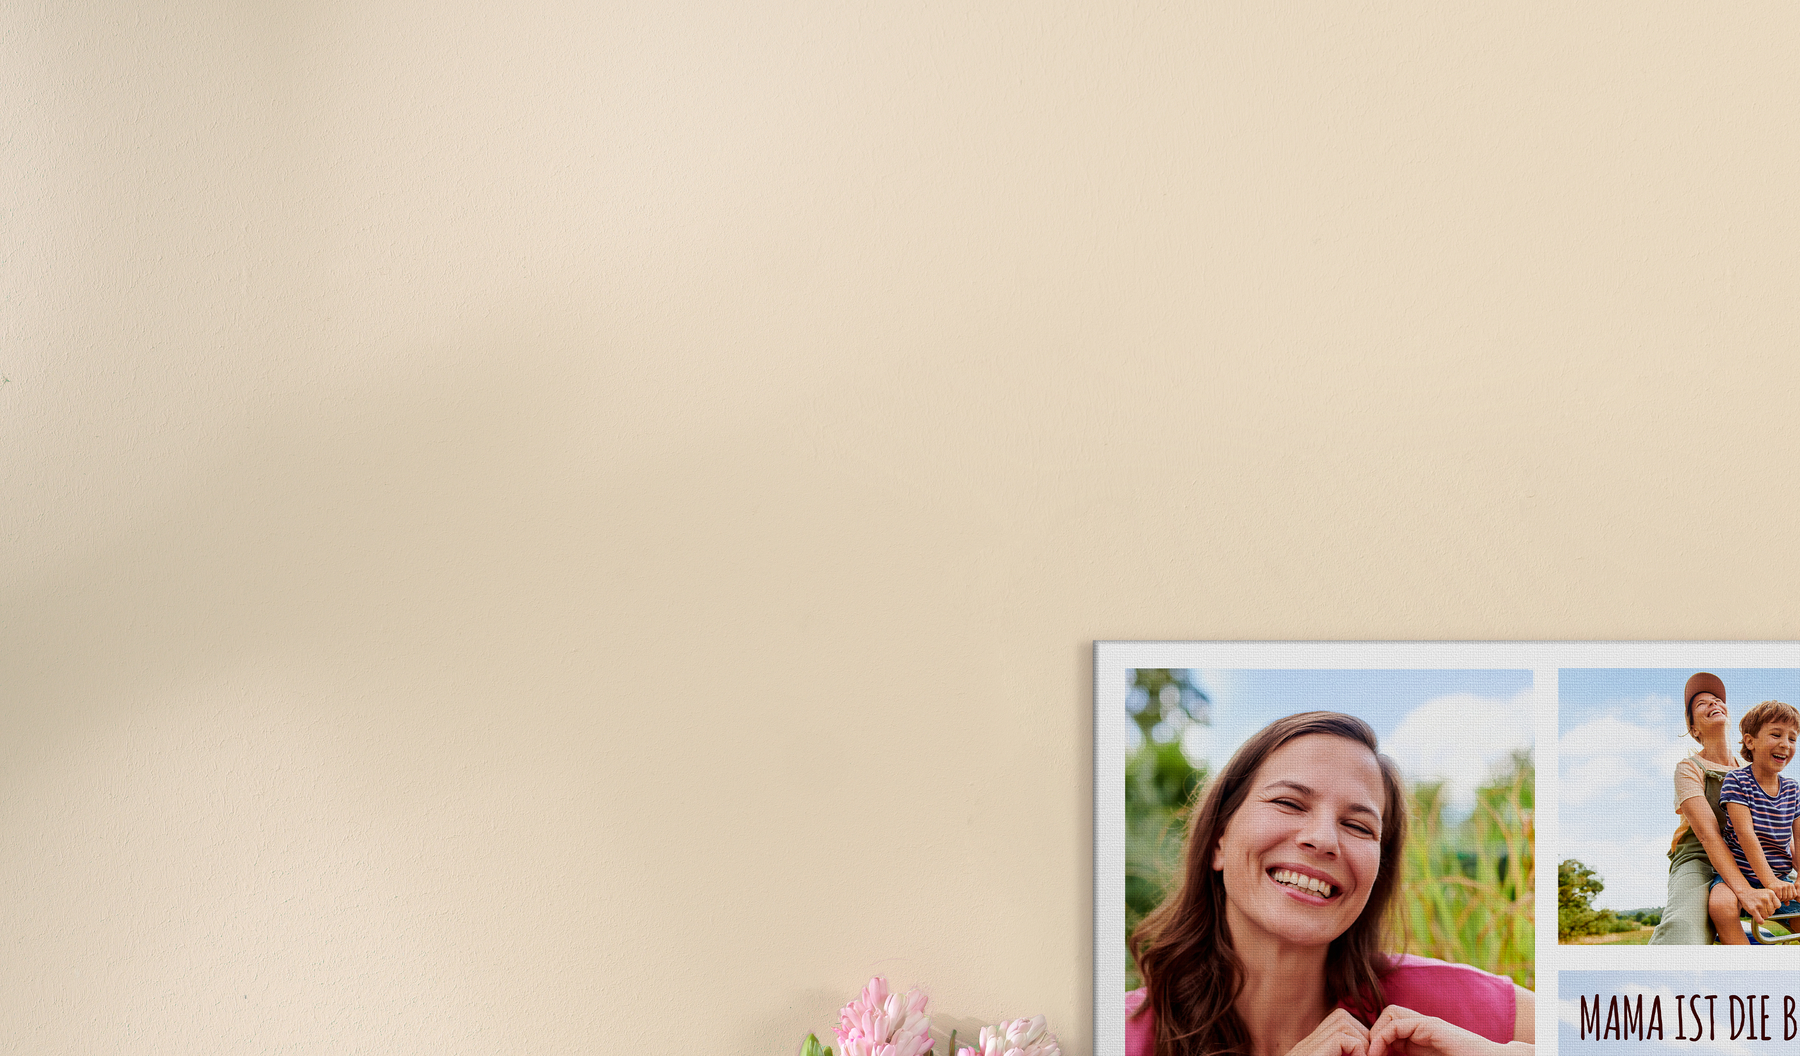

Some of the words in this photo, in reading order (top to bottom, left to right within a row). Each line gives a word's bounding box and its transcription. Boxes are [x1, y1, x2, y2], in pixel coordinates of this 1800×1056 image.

[1580, 993, 1663, 1041] MAMA
[1675, 994, 1718, 1042] IST
[1729, 994, 1772, 1041] DIE
